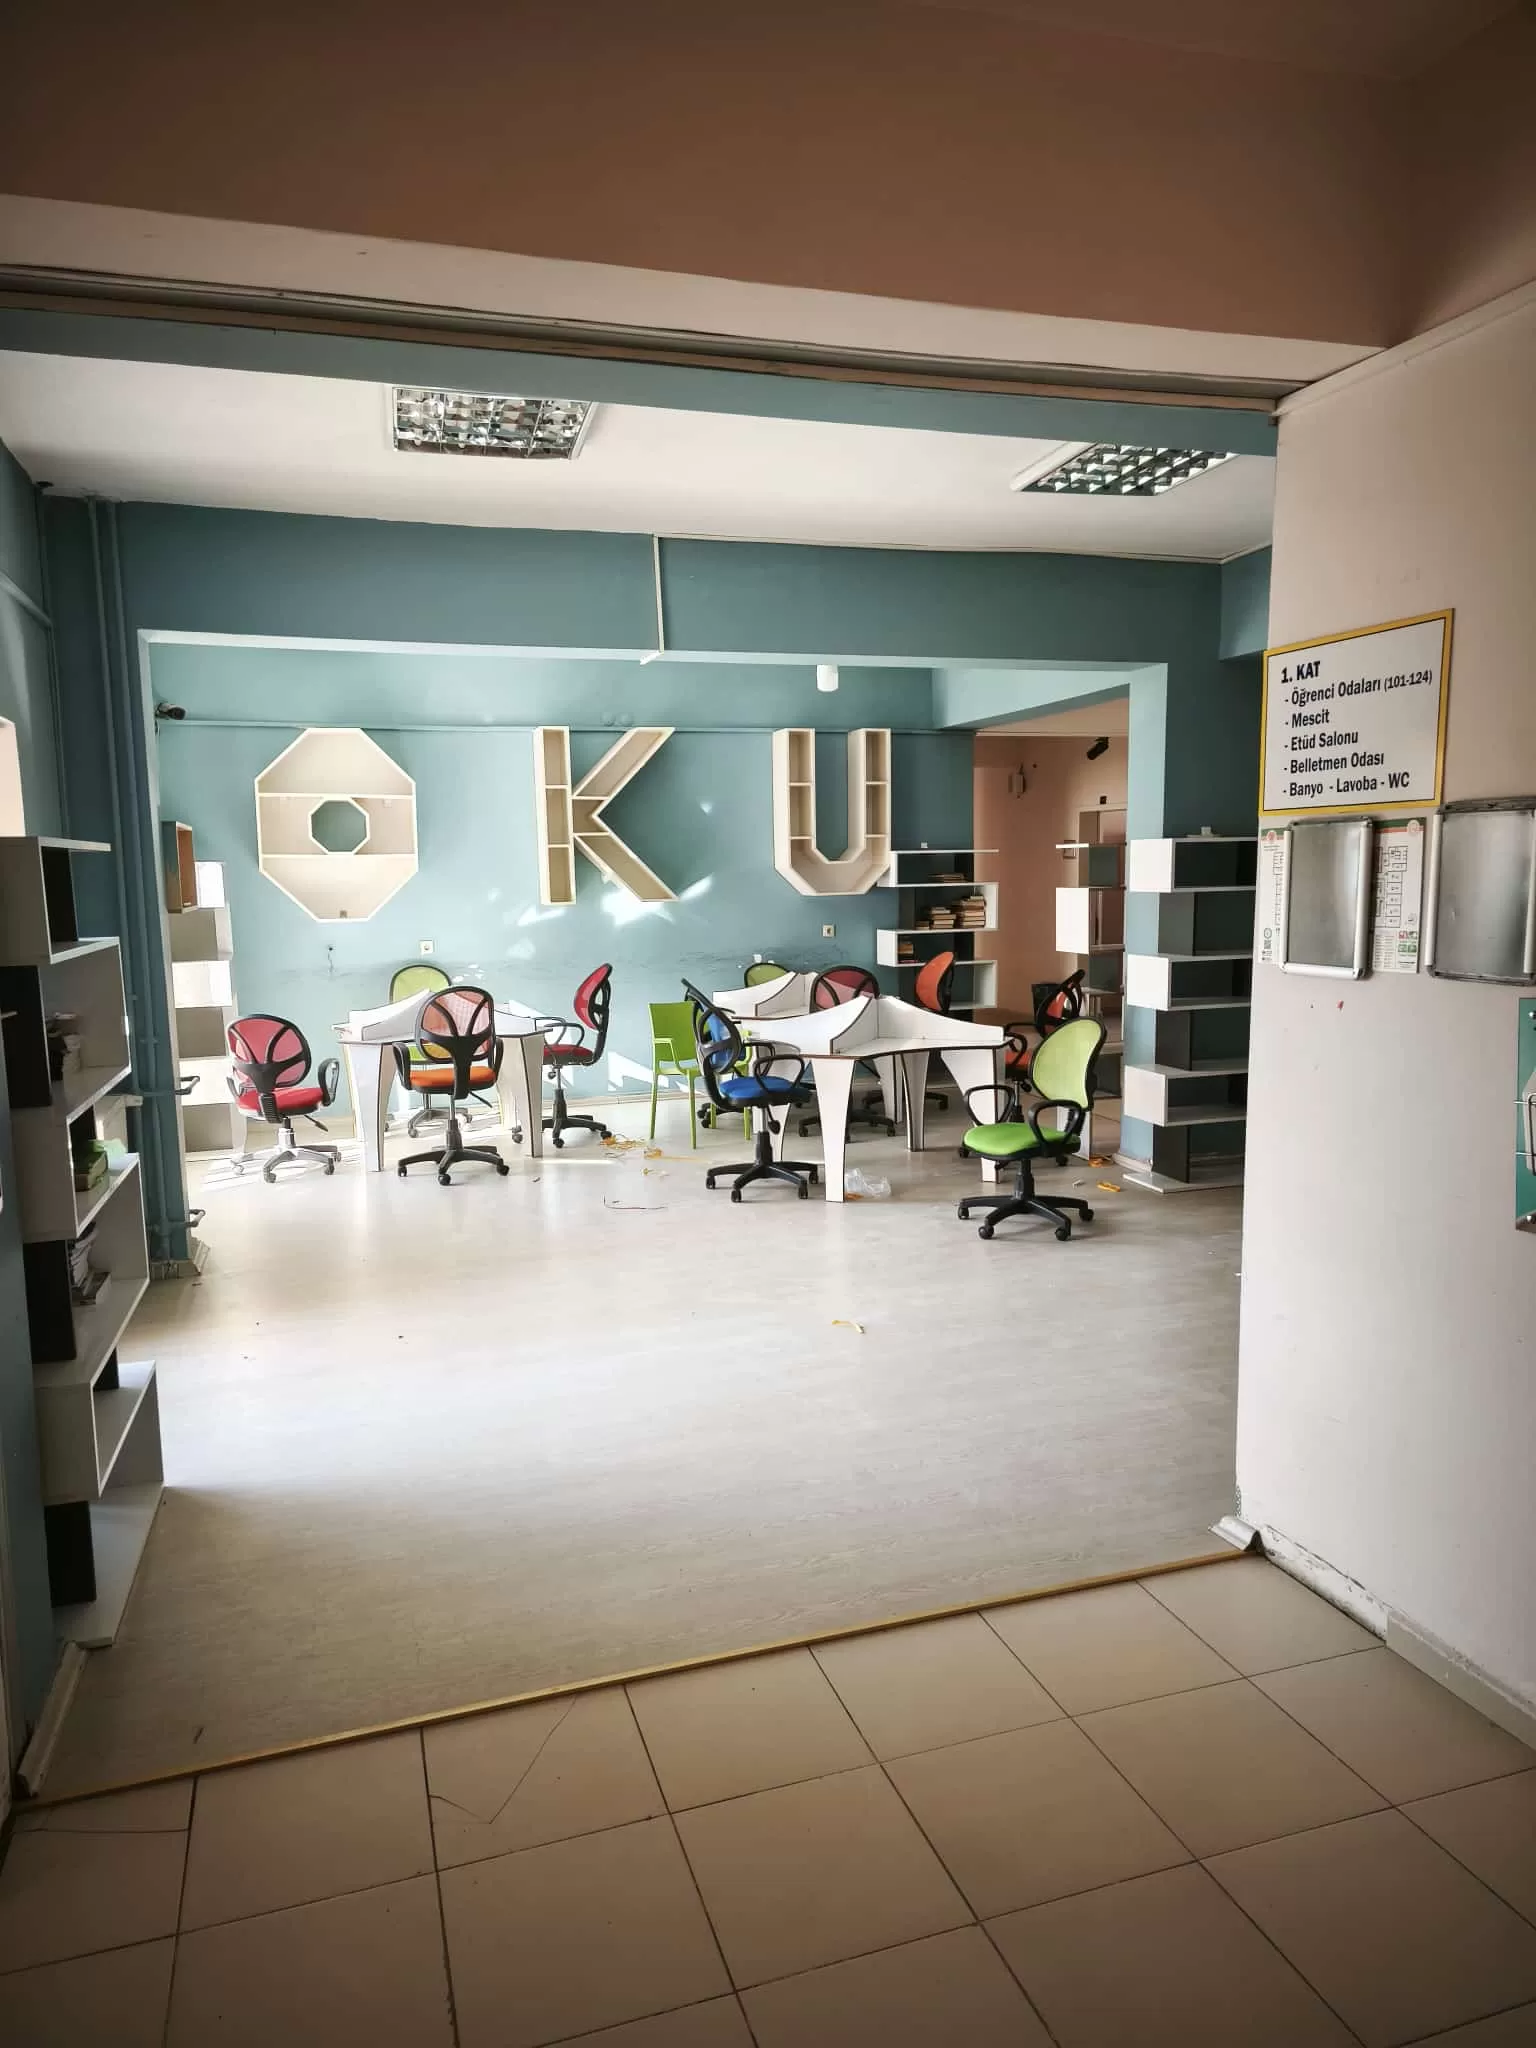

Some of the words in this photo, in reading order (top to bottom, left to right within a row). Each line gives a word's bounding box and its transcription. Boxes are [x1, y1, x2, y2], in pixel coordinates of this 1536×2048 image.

[1281, 667, 1292, 683] 1.
[1297, 661, 1320, 681] KAT
[1292, 684, 1334, 707] Öğrenci
[1338, 678, 1381, 697] Odaları
[1384, 670, 1432, 692] (101-124)
[1292, 709, 1330, 728] Mescit
[1291, 734, 1315, 751] Etüd
[1319, 731, 1358, 745] Salonu
[1290, 755, 1347, 774] Belletmen
[1351, 753, 1384, 767] Odası
[1290, 782, 1323, 798] Banyo
[1337, 778, 1377, 793] Lavoba
[1388, 772, 1410, 788] WC
